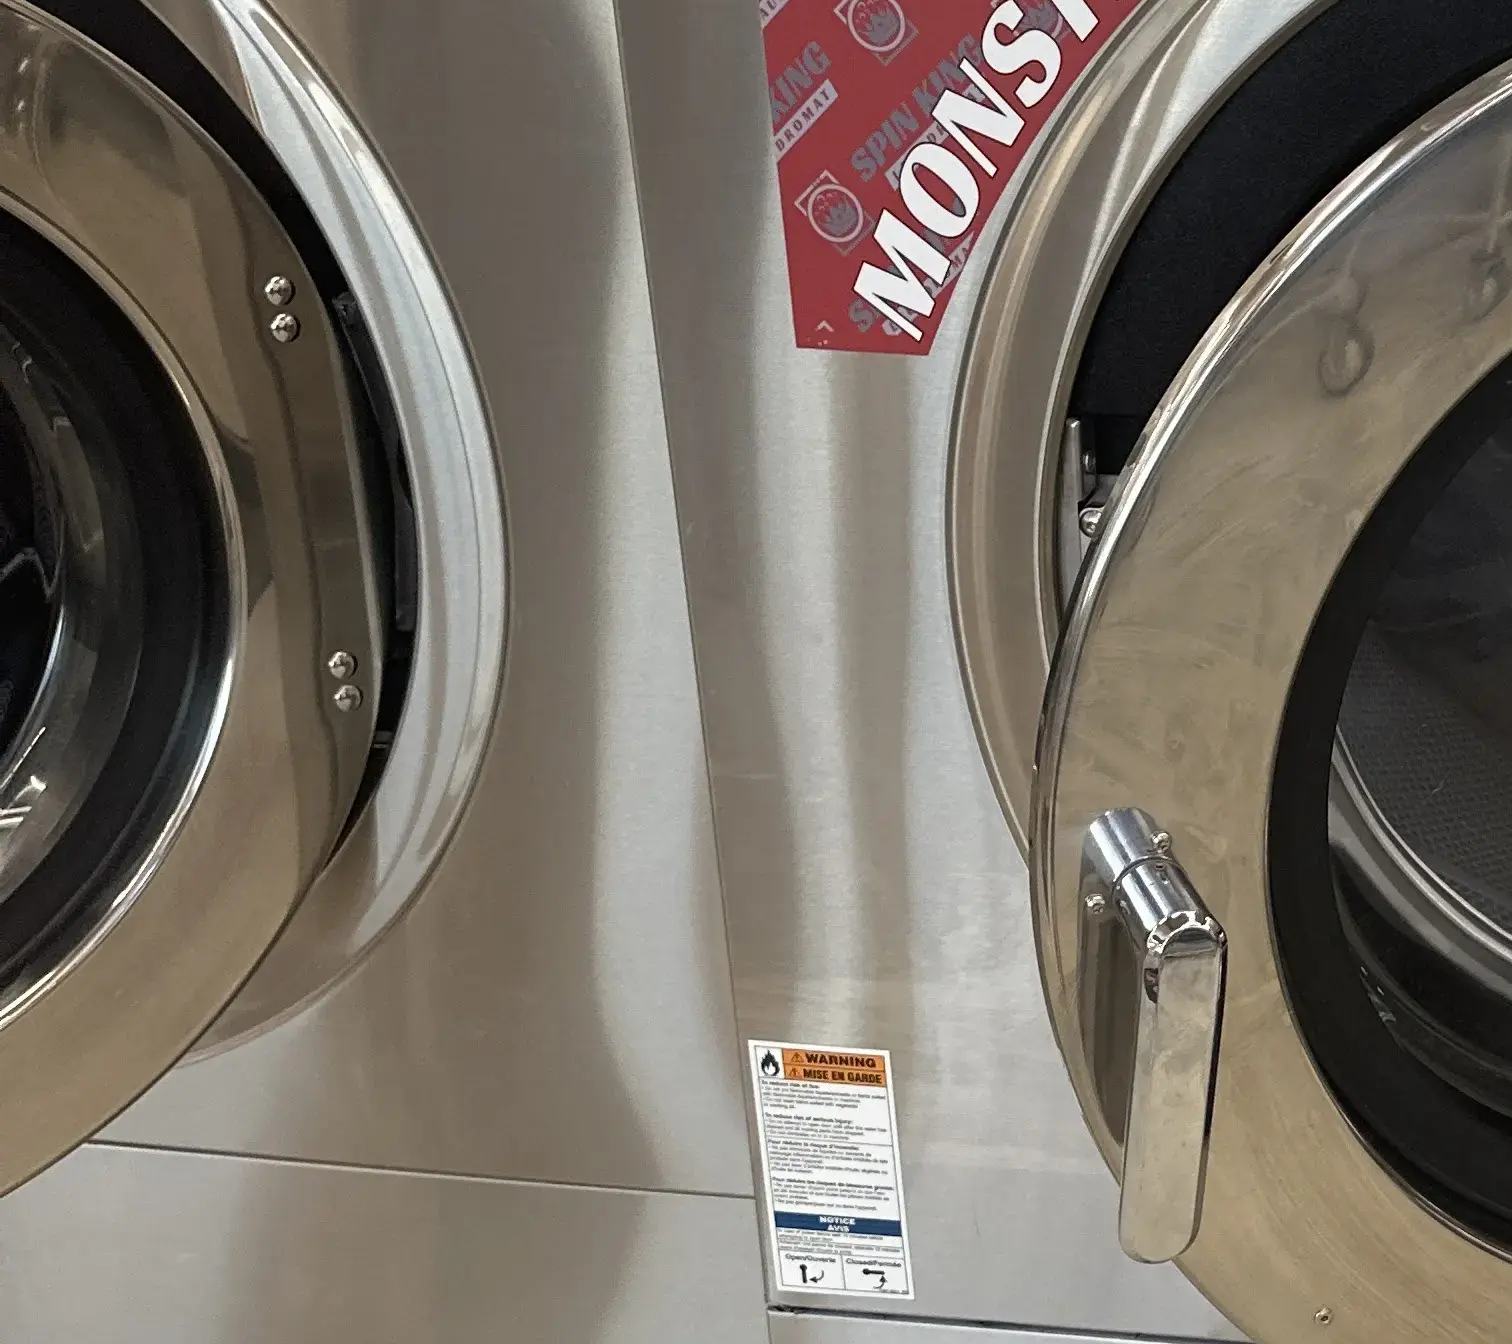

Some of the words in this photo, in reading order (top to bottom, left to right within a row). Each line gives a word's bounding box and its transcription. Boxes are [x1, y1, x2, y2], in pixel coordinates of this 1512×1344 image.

[851, 101, 920, 183] SPIN
[804, 1052, 877, 1068] WARNING
[802, 1068, 830, 1080] MISE
[831, 1070, 845, 1081] EN
[847, 1070, 883, 1085] GARDE
[819, 1215, 856, 1226] NOTICE
[827, 1224, 850, 1233] AVIS
